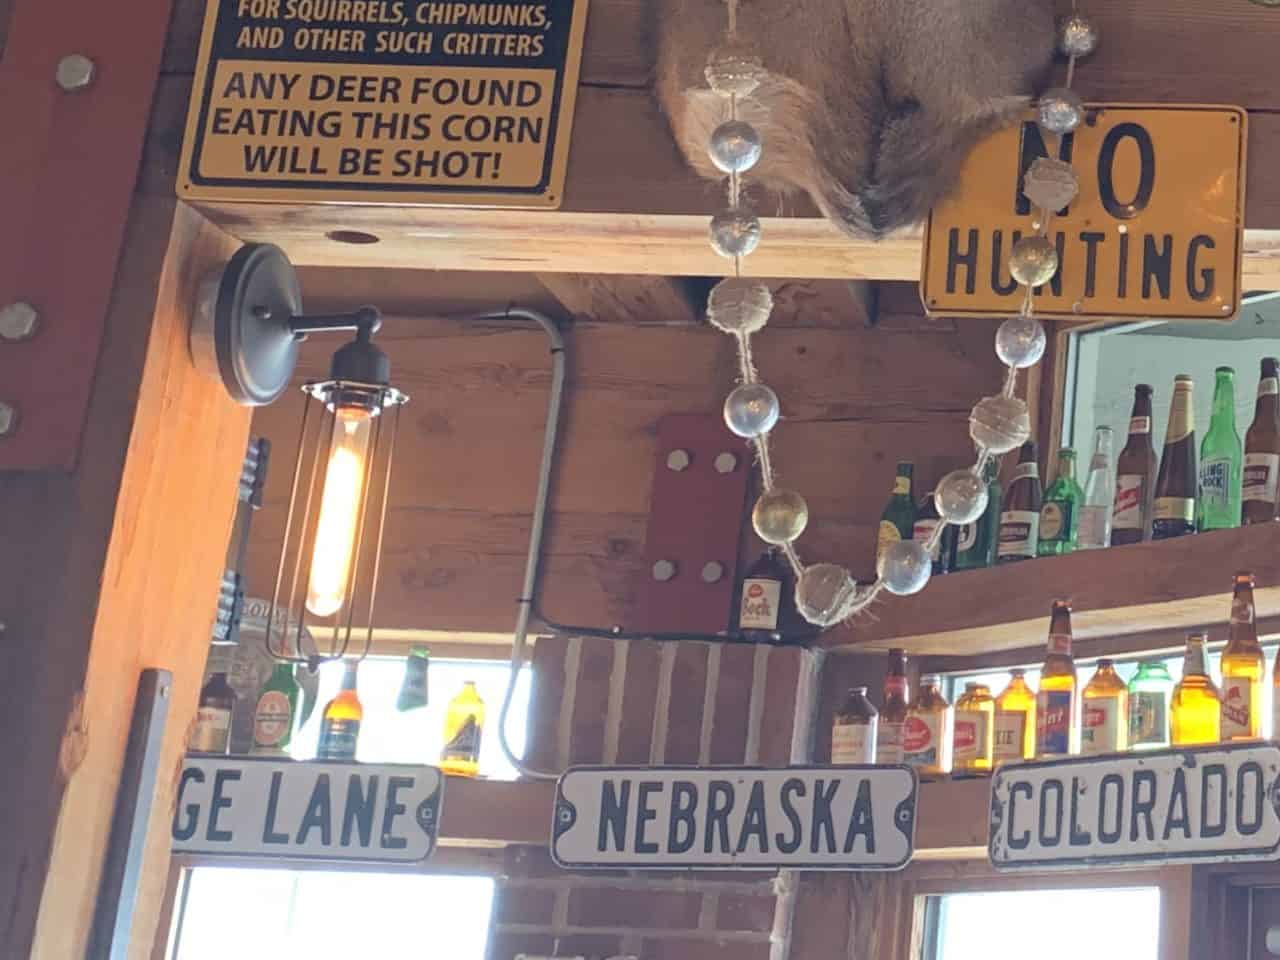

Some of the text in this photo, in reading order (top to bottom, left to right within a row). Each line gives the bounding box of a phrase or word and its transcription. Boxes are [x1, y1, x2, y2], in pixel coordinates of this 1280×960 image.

[285, 0, 410, 27] SQUIRRELS,
[415, 2, 553, 30] CHIPMUNKS,
[237, 27, 544, 56] AND OTHER SUCH CRITTERS
[224, 72, 542, 107] ANY DEER FOUND
[212, 108, 544, 144] EATING THIS CORN
[243, 145, 502, 179] WILL BE SHOT!
[1016, 121, 1155, 220] NO
[172, 767, 415, 849] GE LANE
[597, 777, 876, 854] NEBRASKA
[1007, 760, 1265, 850] COLORADO
